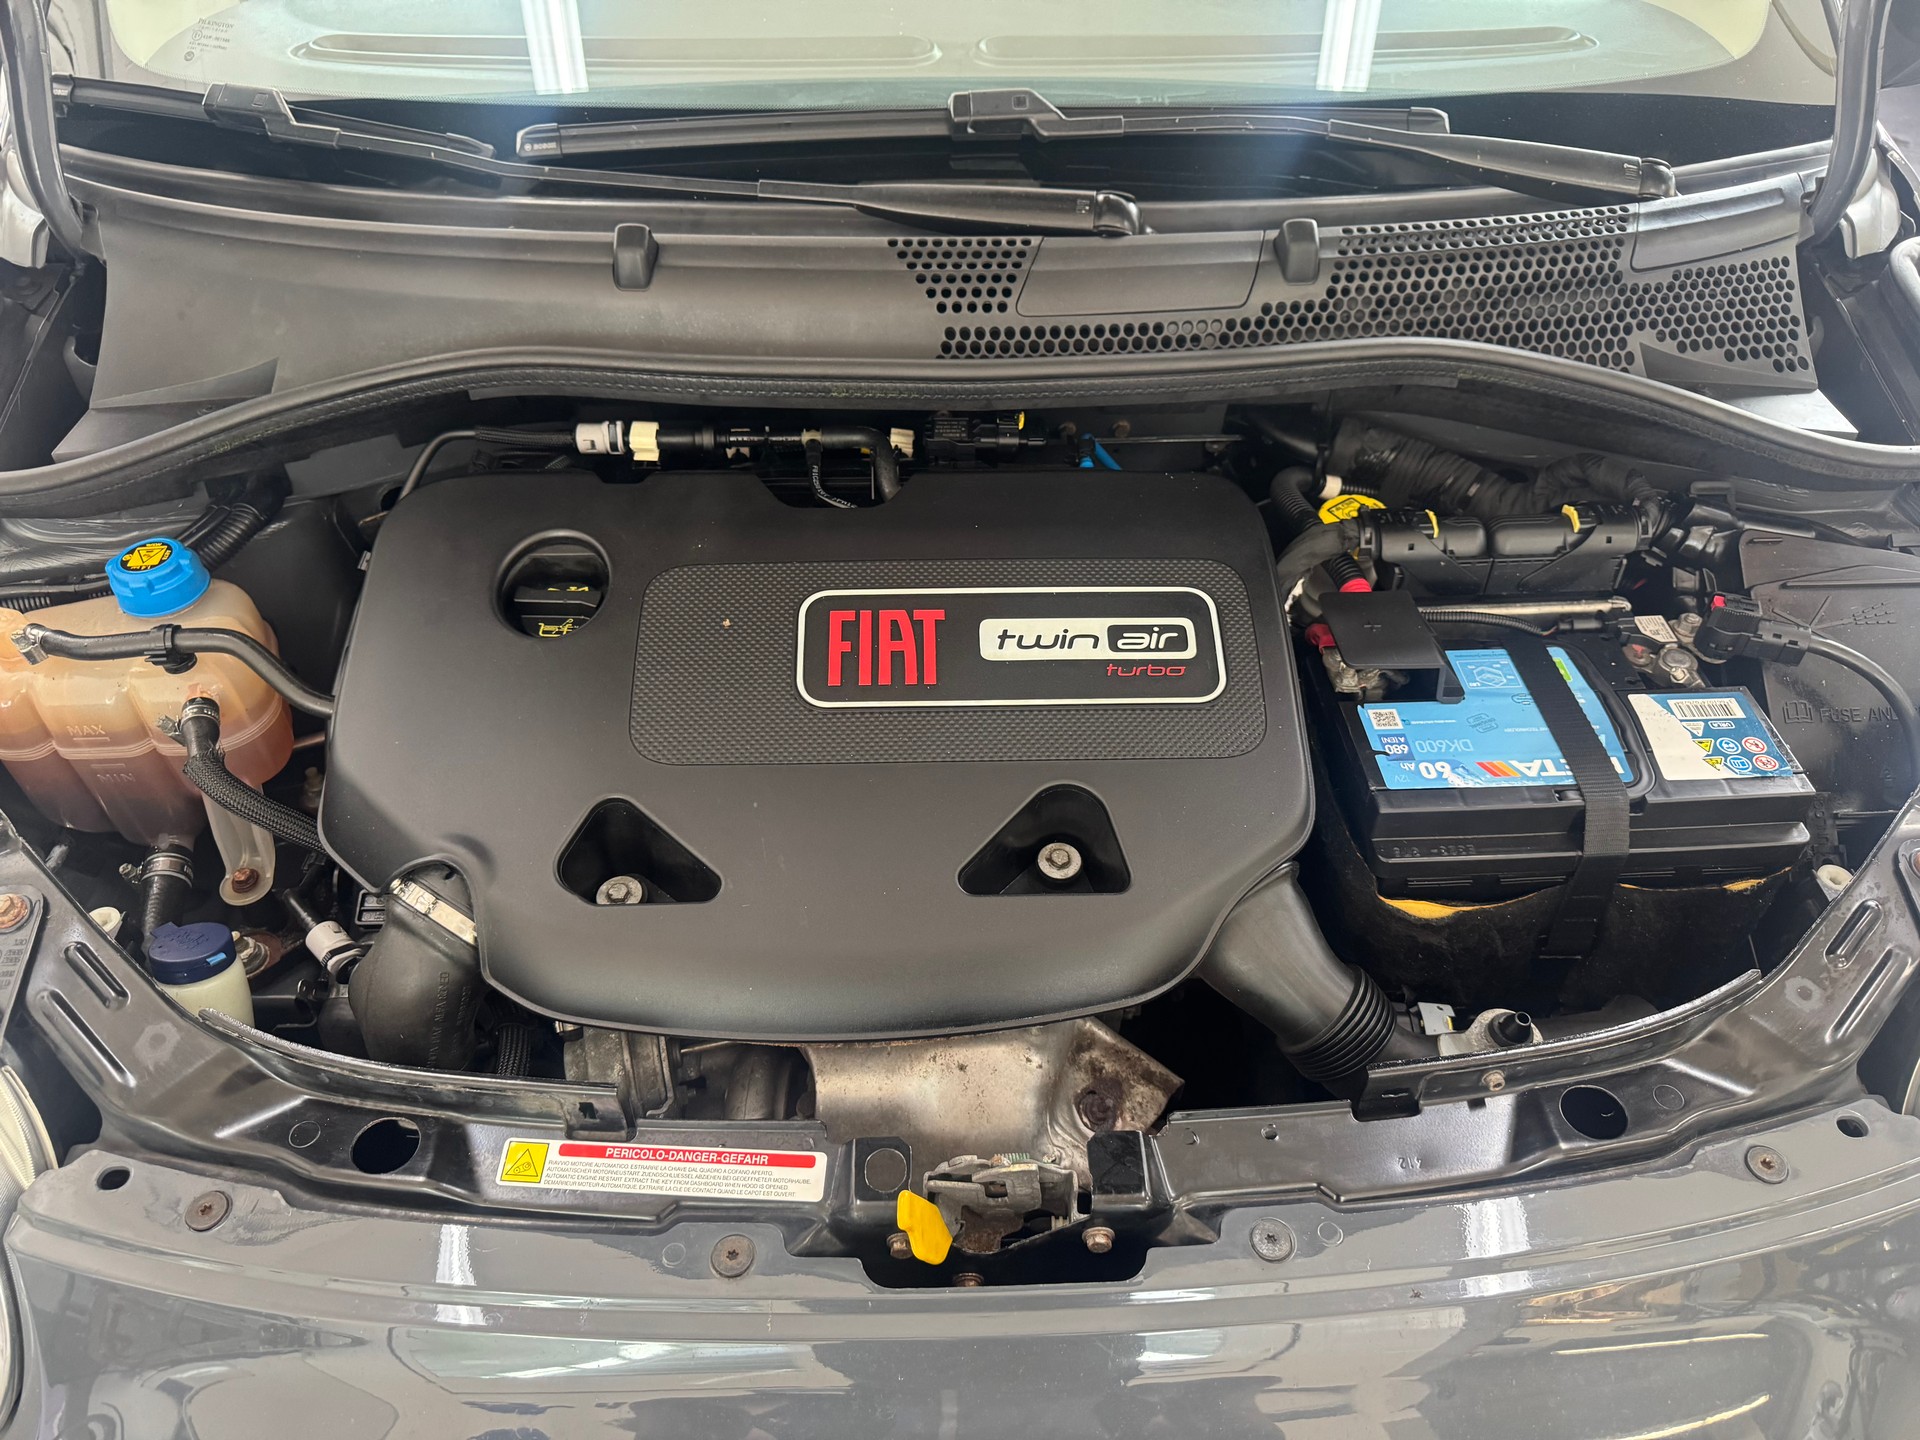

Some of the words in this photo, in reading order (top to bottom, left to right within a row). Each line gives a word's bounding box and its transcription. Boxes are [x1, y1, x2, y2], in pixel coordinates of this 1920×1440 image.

[997, 628, 1100, 651] twin
[1116, 626, 1179, 650] air
[827, 609, 946, 687] FIAT
[1106, 663, 1187, 677] turbo
[1820, 707, 1862, 722] FUSE
[66, 725, 106, 736] MAX
[1384, 744, 1409, 755] 680
[1414, 738, 1475, 753] DK600
[1400, 761, 1415, 771] Ah
[1418, 761, 1452, 779] 60
[96, 772, 136, 783] MIN
[605, 1147, 768, 1165] PERICOLO-DANGER-GEFAHR
[544, 1179, 577, 1187] DEMARREUR
[641, 1171, 694, 1179] ZUENDSCHLUESSEL
[732, 1175, 773, 1183] GEOEFFNETER
